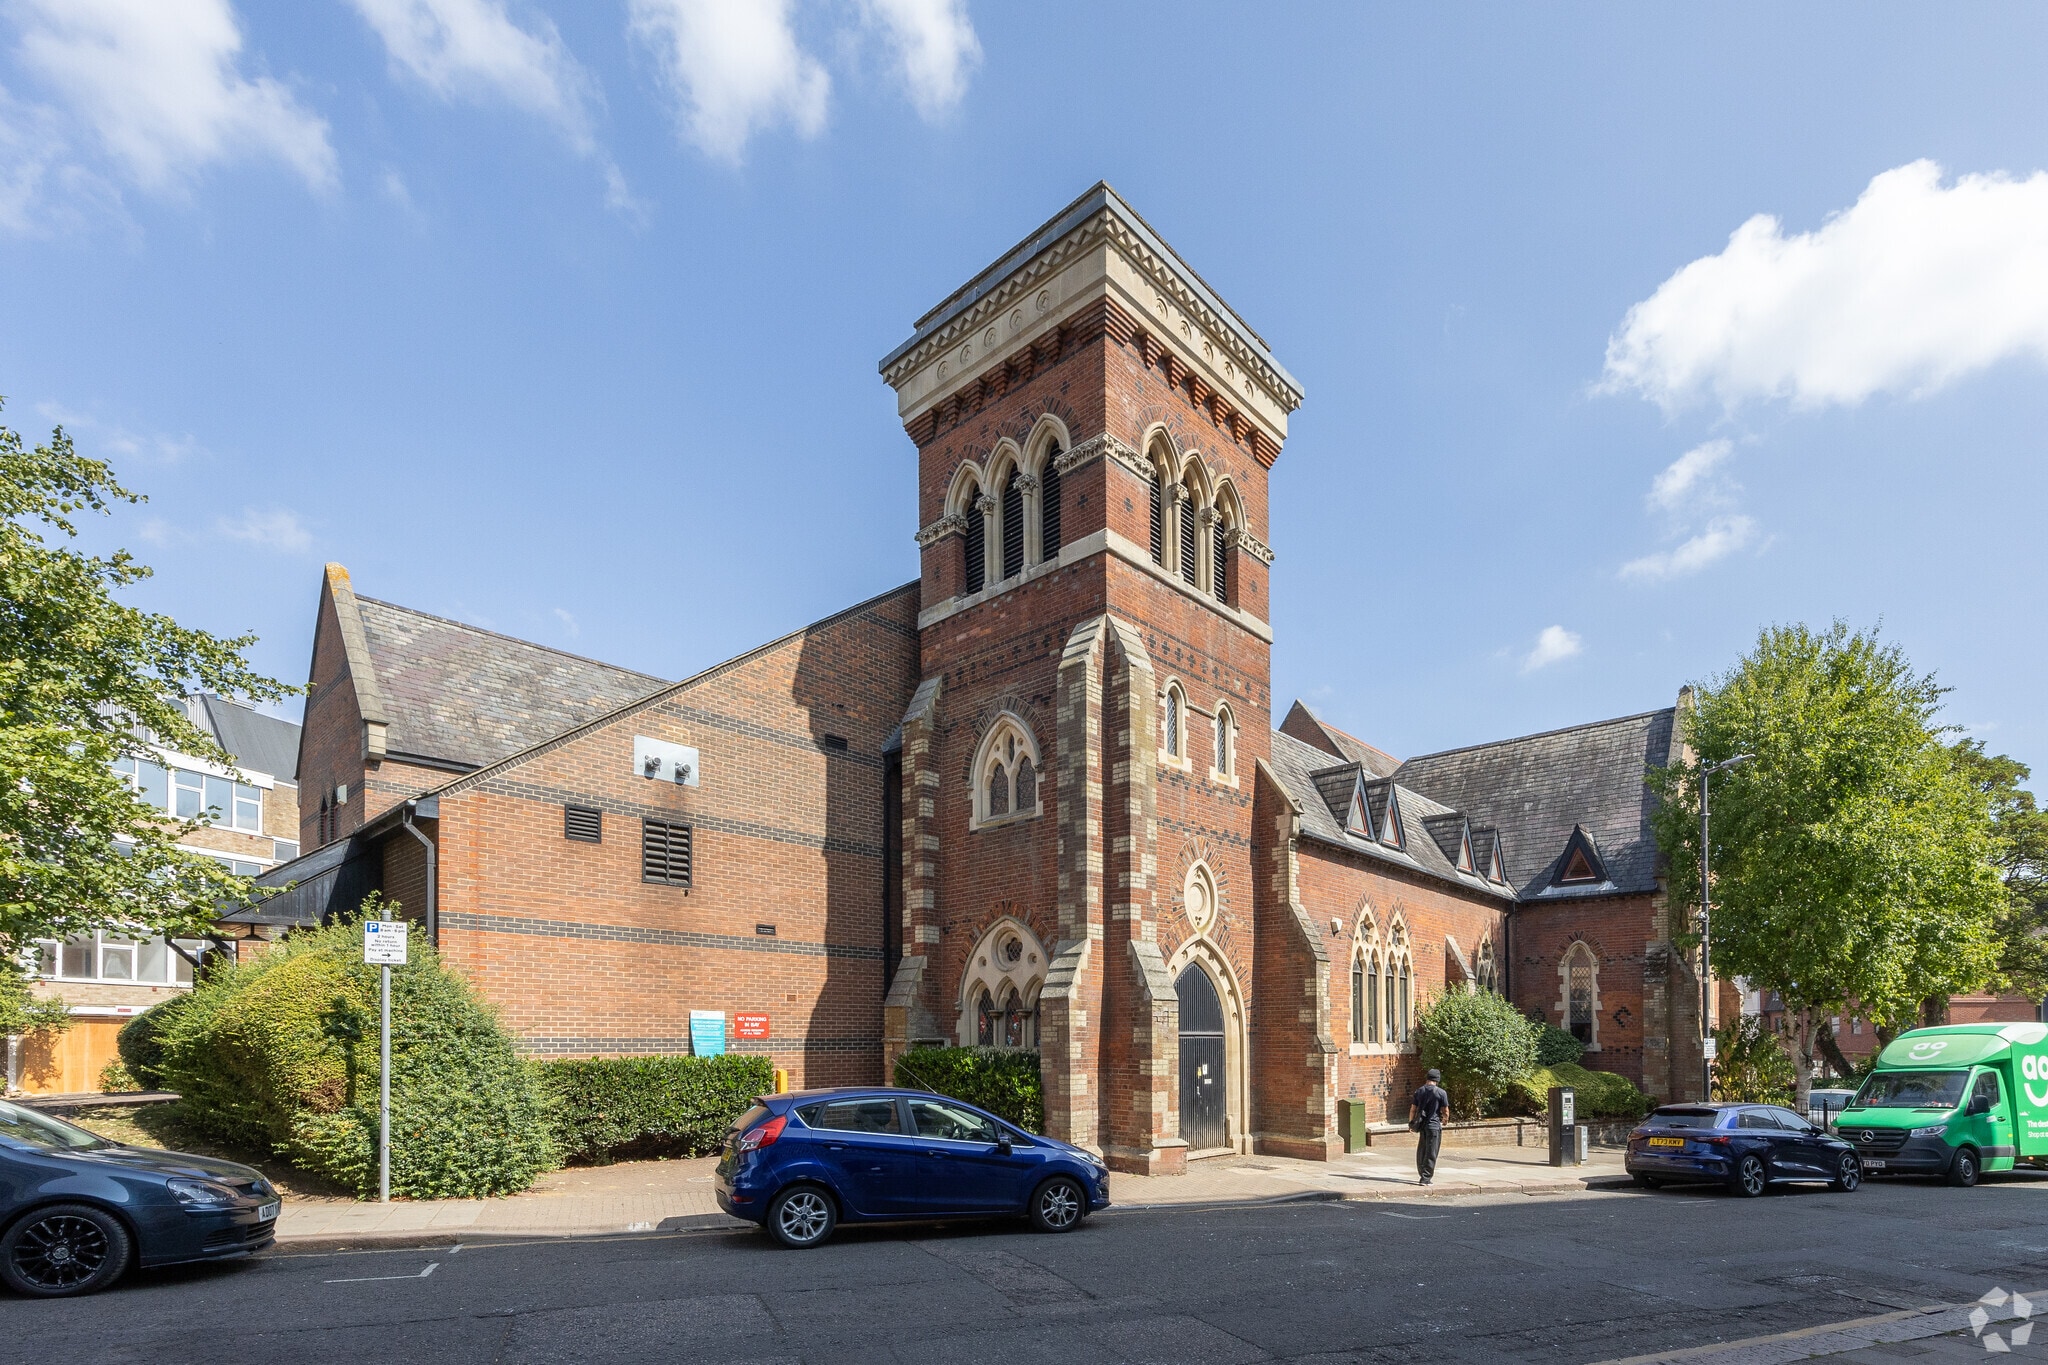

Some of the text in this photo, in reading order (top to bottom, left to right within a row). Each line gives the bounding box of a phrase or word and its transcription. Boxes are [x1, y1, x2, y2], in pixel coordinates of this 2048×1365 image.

[369, 923, 377, 932] P
[1913, 1041, 1948, 1051] ao
[2027, 1120, 2038, 1128] The
